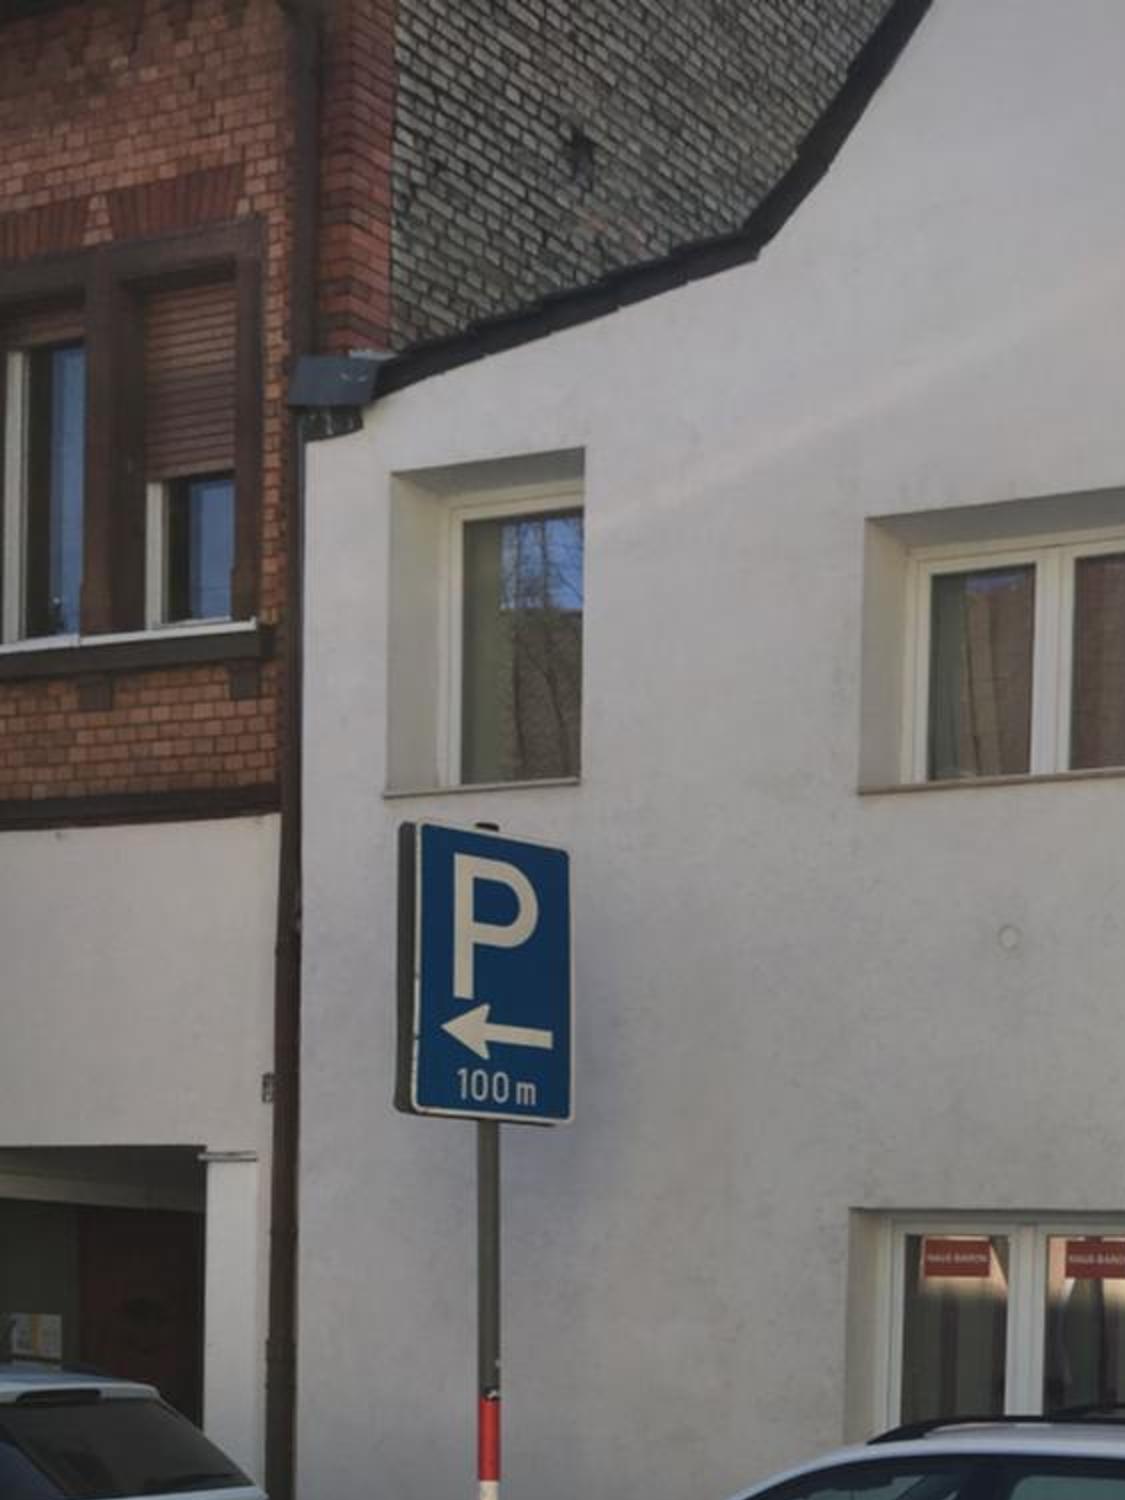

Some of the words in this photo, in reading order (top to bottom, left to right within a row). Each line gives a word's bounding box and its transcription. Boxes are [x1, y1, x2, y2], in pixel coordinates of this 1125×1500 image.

[453, 851, 539, 1000] P
[456, 1067, 510, 1103] 100
[516, 1080, 537, 1106] m
